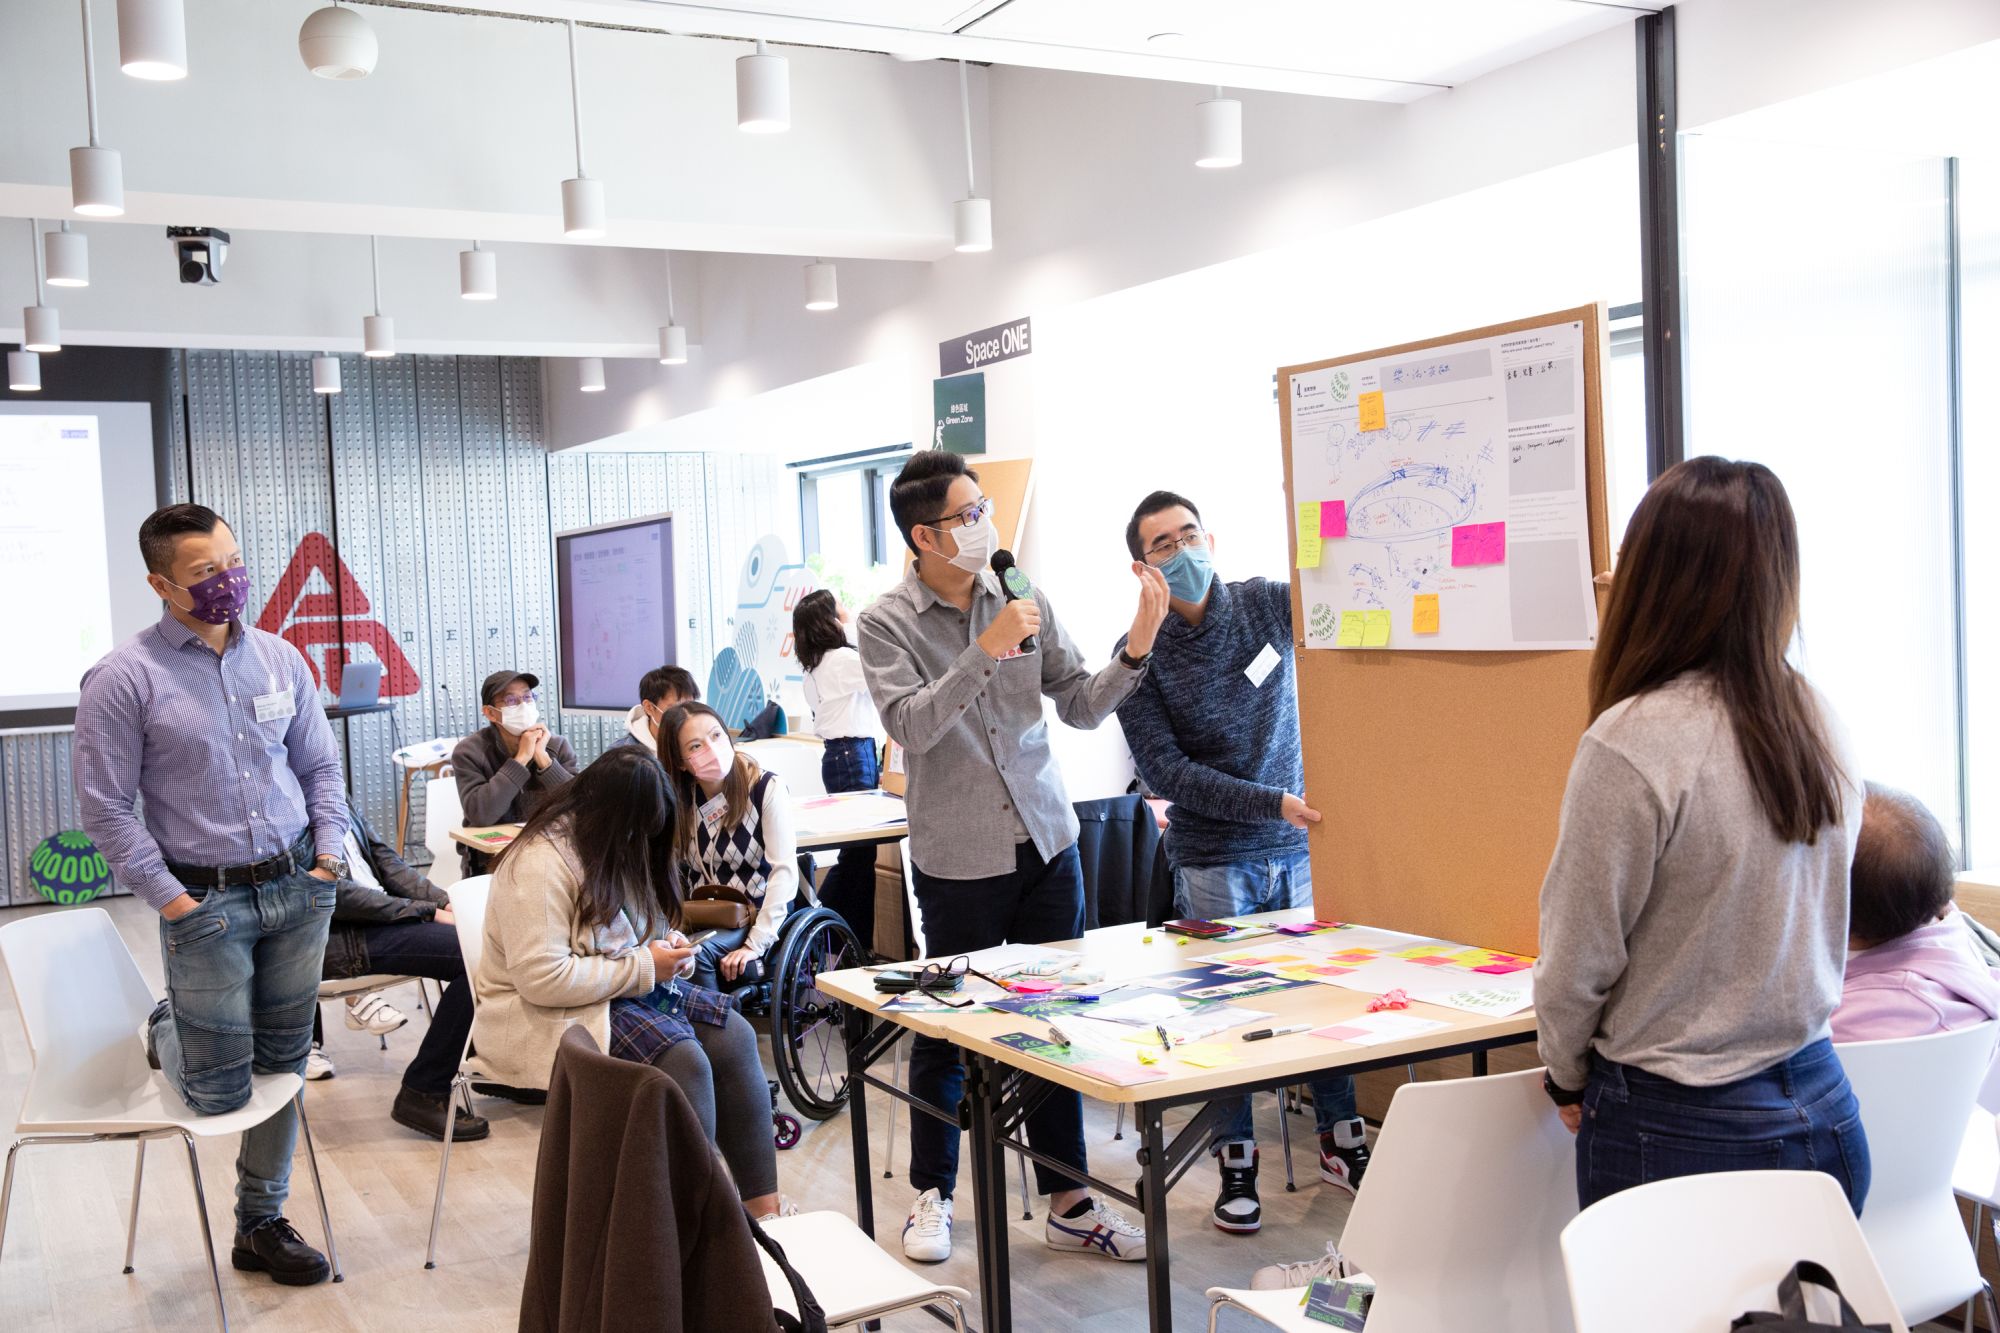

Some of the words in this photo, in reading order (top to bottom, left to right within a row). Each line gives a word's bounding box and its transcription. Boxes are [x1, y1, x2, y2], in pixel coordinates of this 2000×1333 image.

[965, 339, 1000, 369] Space
[1001, 323, 1028, 355] ONE
[945, 416, 961, 425] Green
[961, 415, 974, 423] Zone
